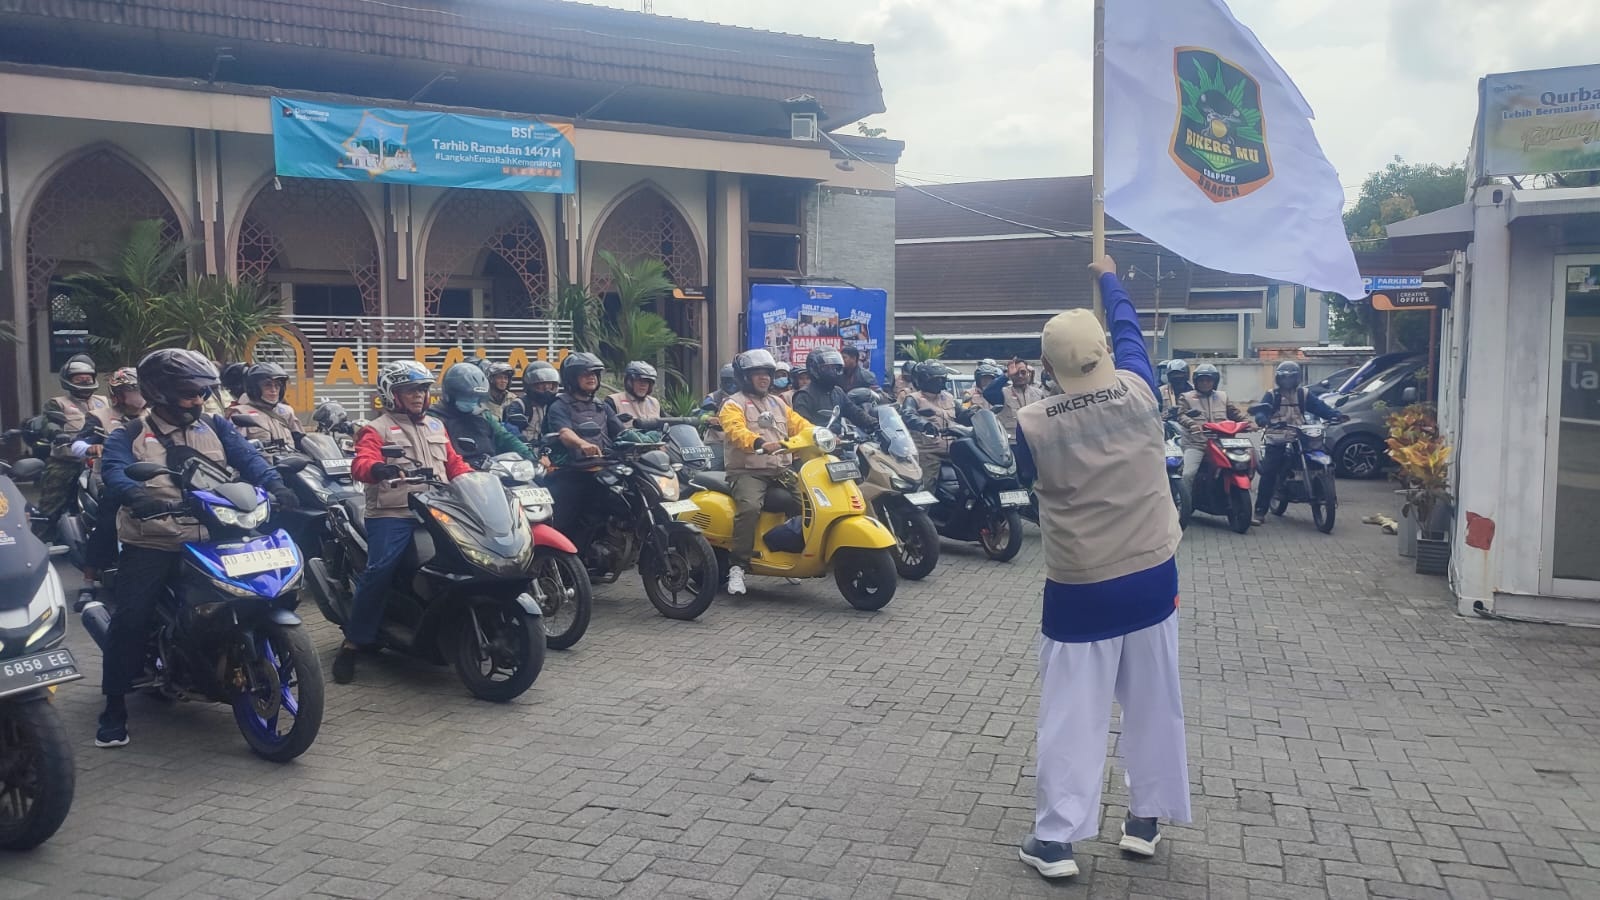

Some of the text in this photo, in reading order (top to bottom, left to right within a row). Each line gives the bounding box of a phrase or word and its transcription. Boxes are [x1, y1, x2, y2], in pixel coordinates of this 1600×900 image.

[1503, 108, 1532, 119] Lebih
[432, 139, 561, 158] Tarhib Ramadan 1447 H
[1185, 128, 1232, 155] BIKERS
[1235, 146, 1260, 163] MU
[435, 152, 561, 168] #LangkahEmasRaihKemenangan
[434, 321, 500, 339] RAYA
[4, 653, 70, 676] 6858 EE
